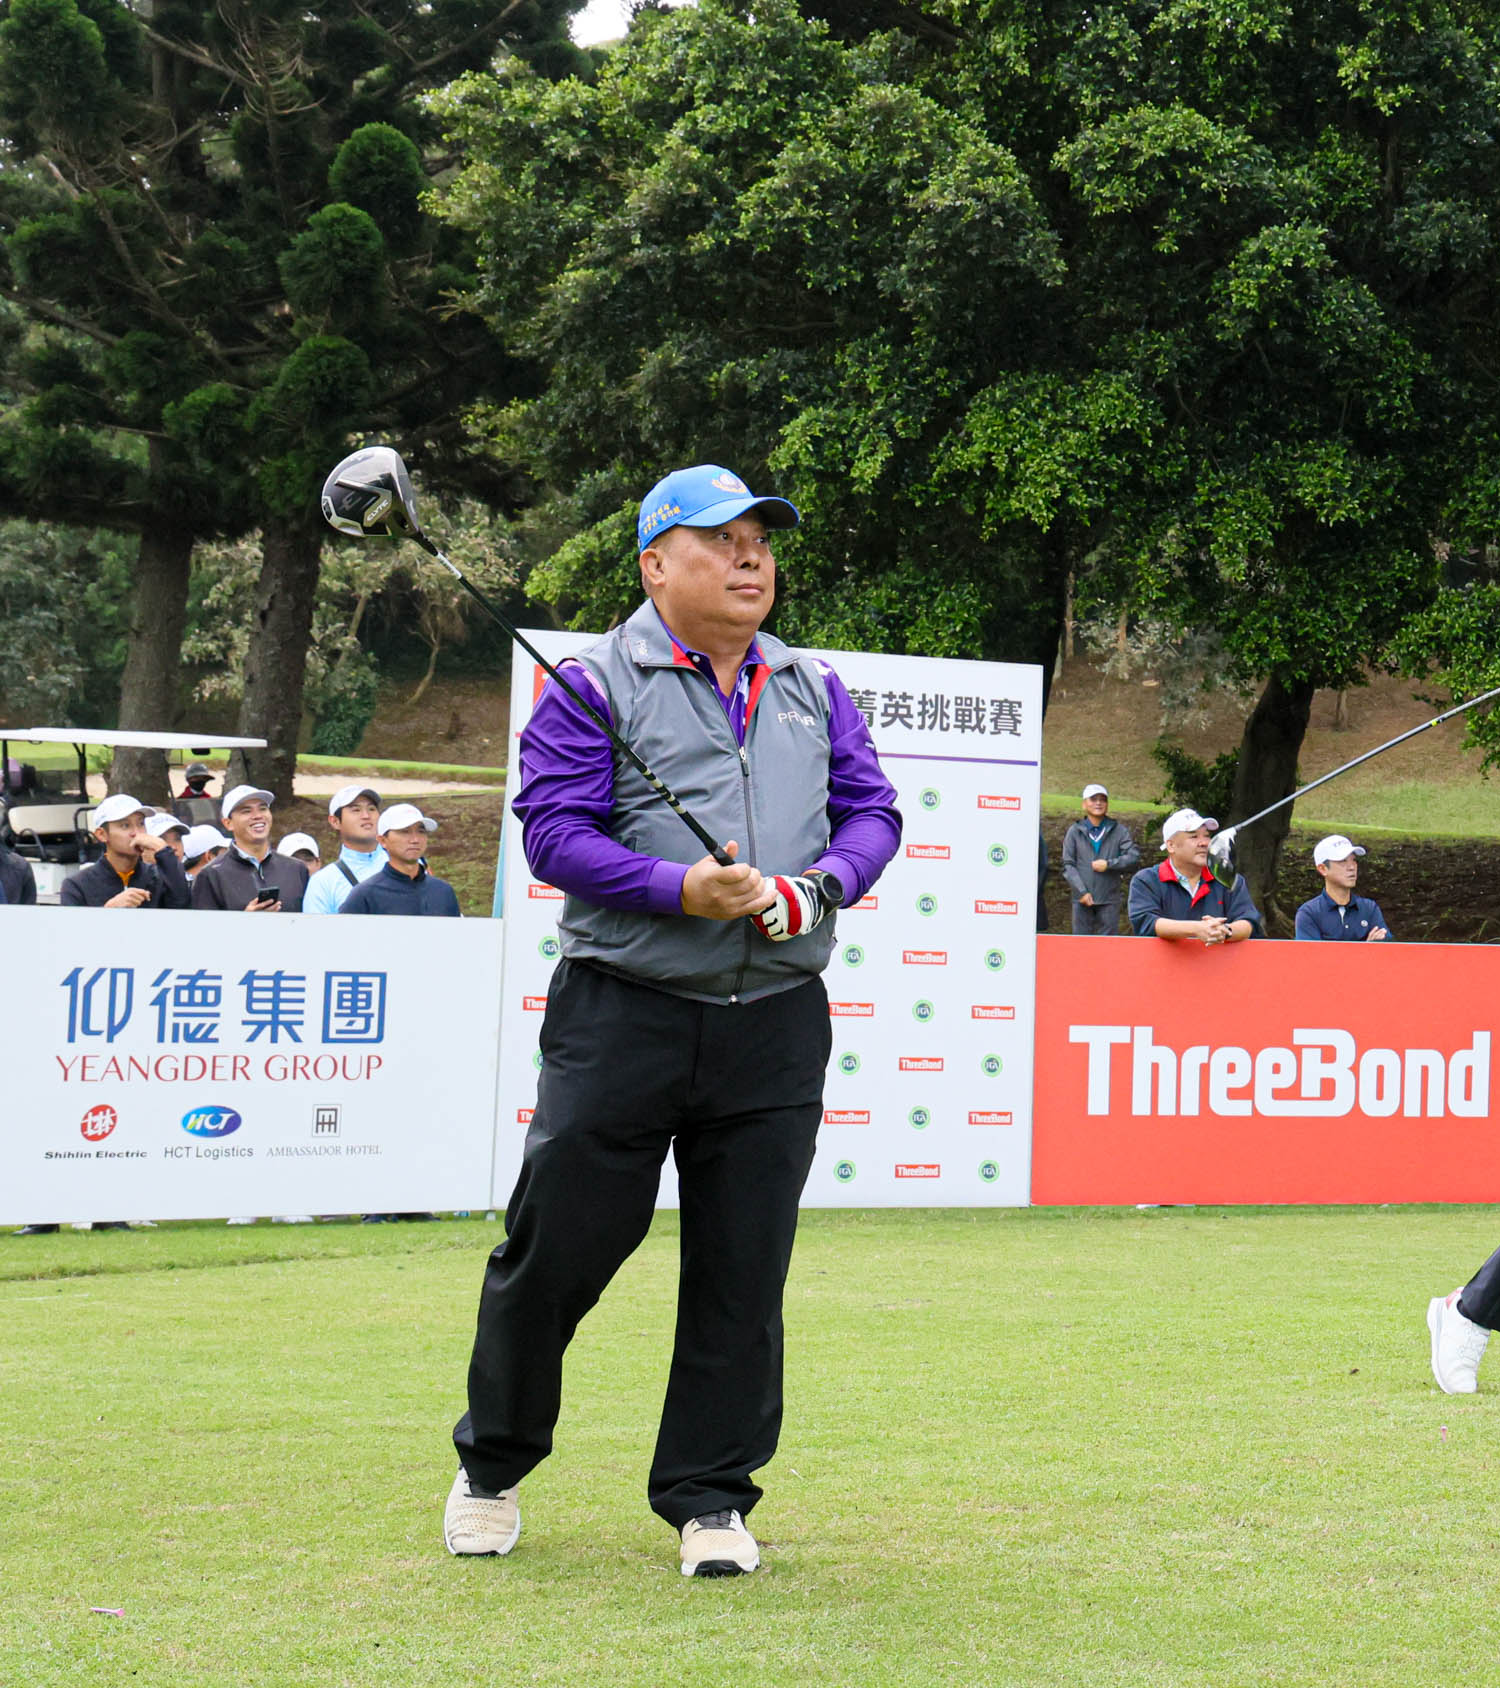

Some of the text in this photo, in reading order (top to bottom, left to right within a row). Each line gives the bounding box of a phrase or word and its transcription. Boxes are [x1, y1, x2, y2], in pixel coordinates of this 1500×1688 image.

[848, 688, 1022, 737] 菁英挑戰賽
[61, 967, 388, 1045] 仰德集團
[55, 1055, 383, 1082] YEANGDER GROUP
[1069, 1025, 1491, 1118] ThreeBond
[186, 1113, 235, 1131] HCT
[44, 1150, 148, 1160] Shihlin Electric
[163, 1146, 254, 1161] HCT Logistics
[266, 1144, 382, 1157] AMBASSADOR HOTEL
